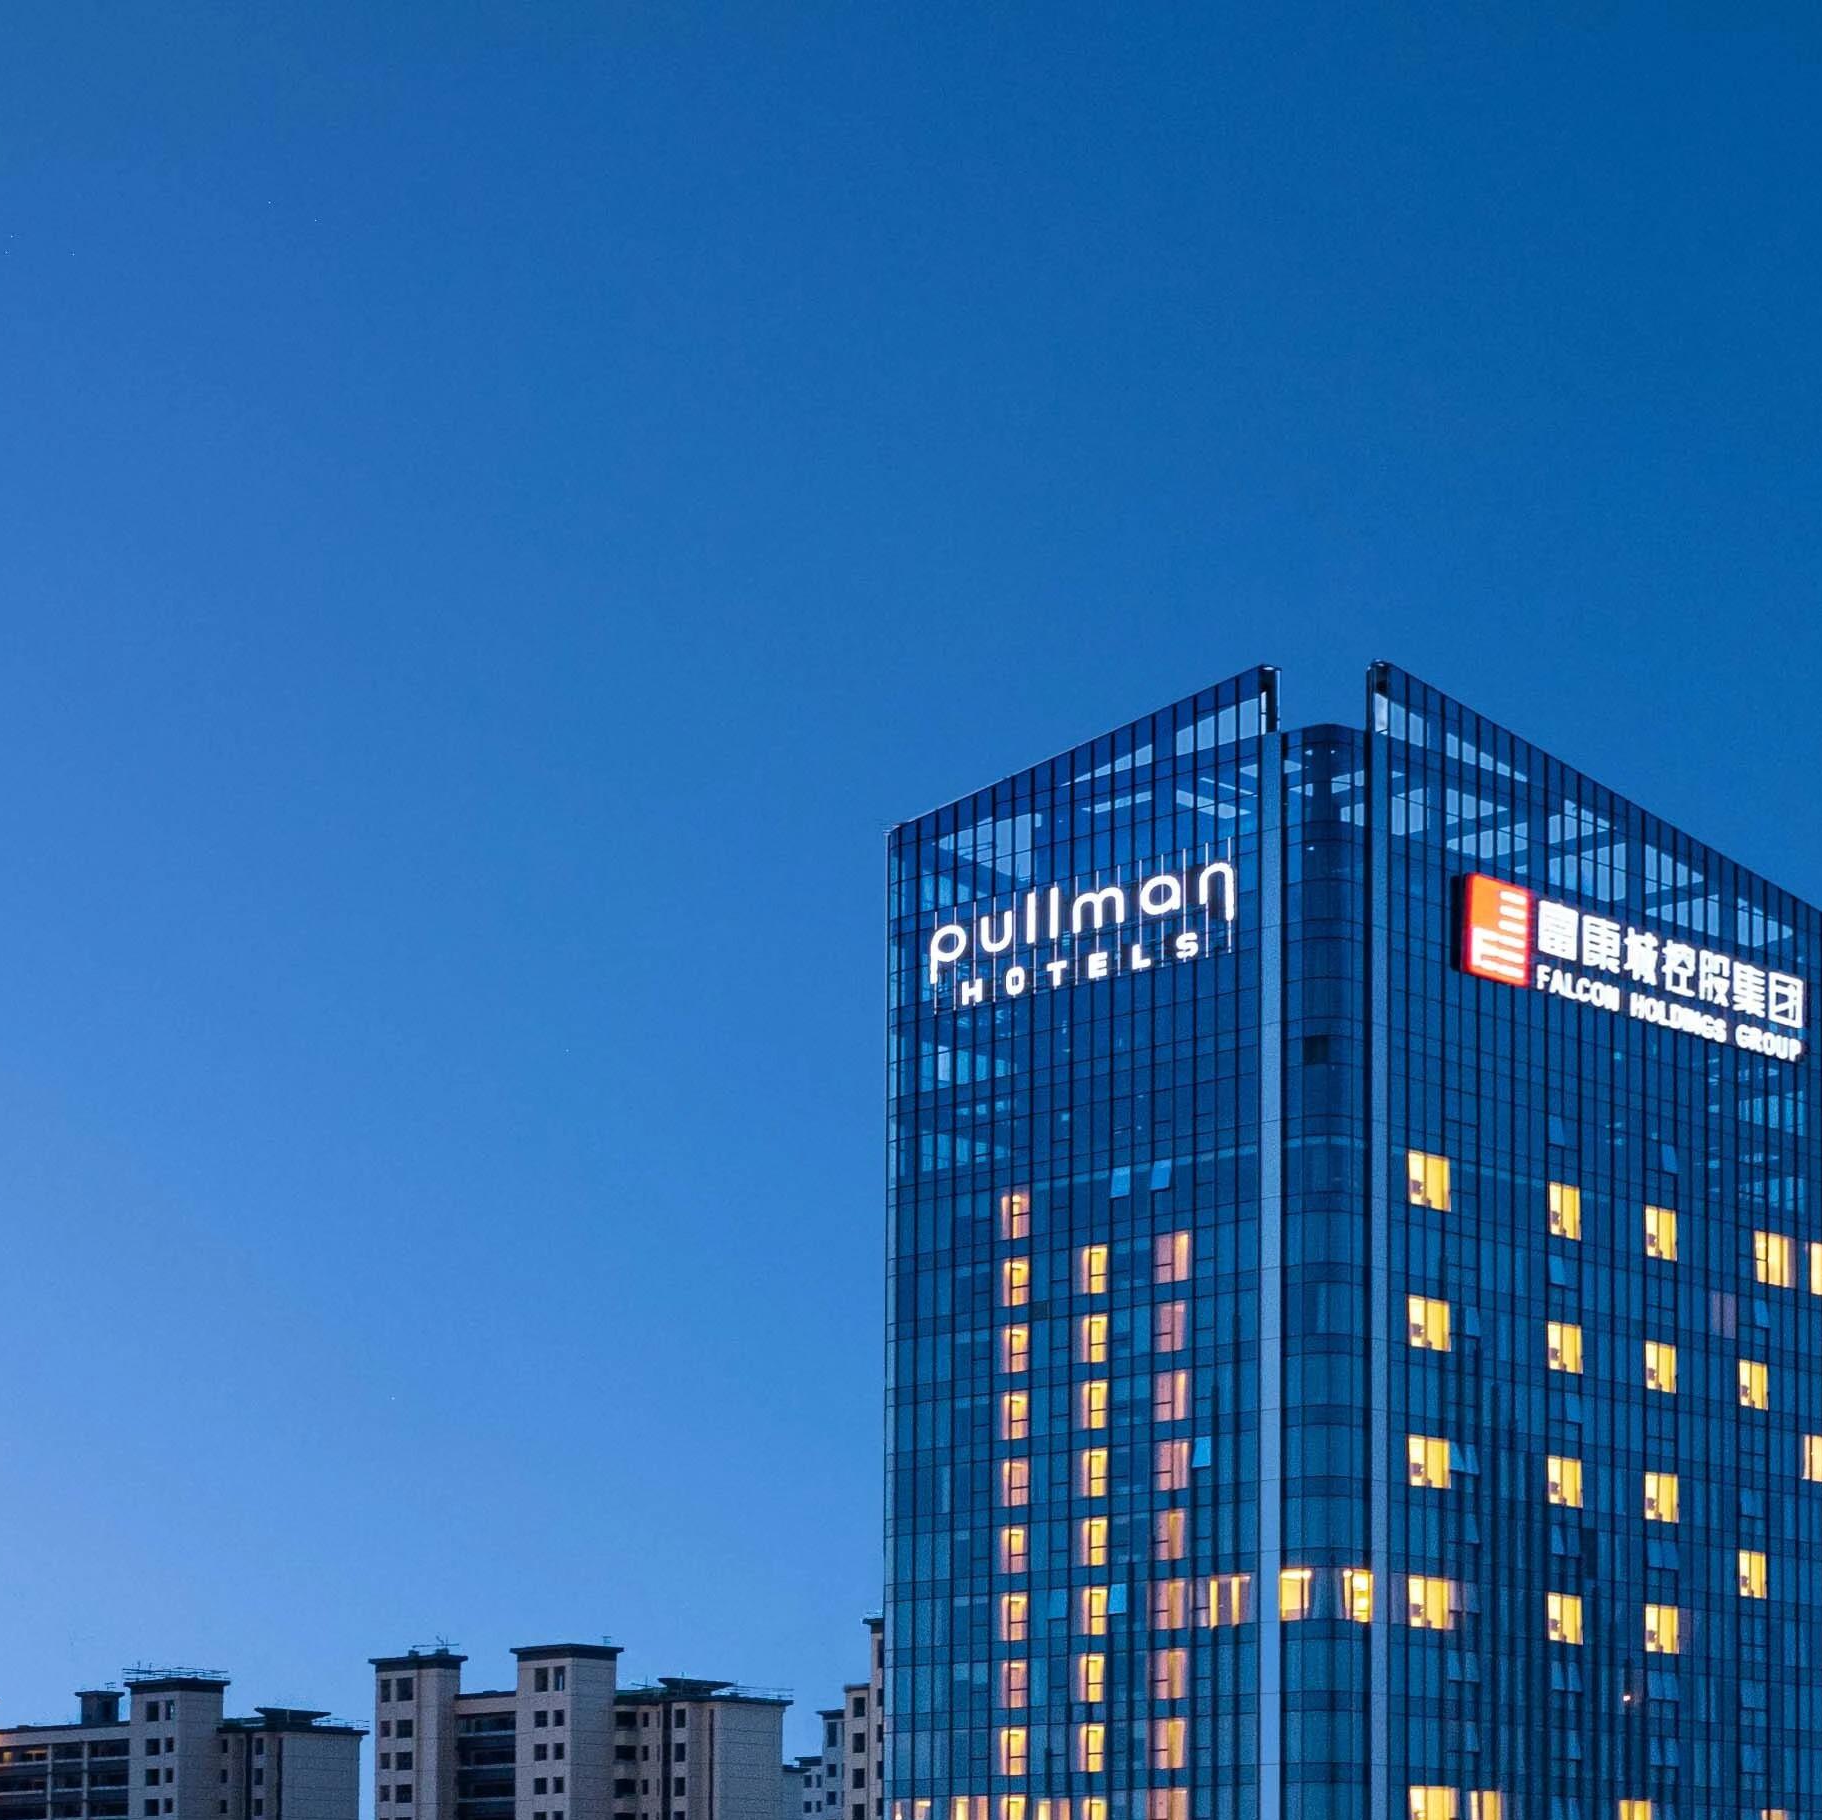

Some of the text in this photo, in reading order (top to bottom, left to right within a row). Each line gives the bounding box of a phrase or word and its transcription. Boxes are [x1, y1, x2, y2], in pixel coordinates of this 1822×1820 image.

[929, 861, 1236, 985] pullman
[961, 931, 1199, 1006] HOTELS
[1536, 964, 1620, 1013] FALCON
[1735, 1023, 1802, 1063] GROUP
